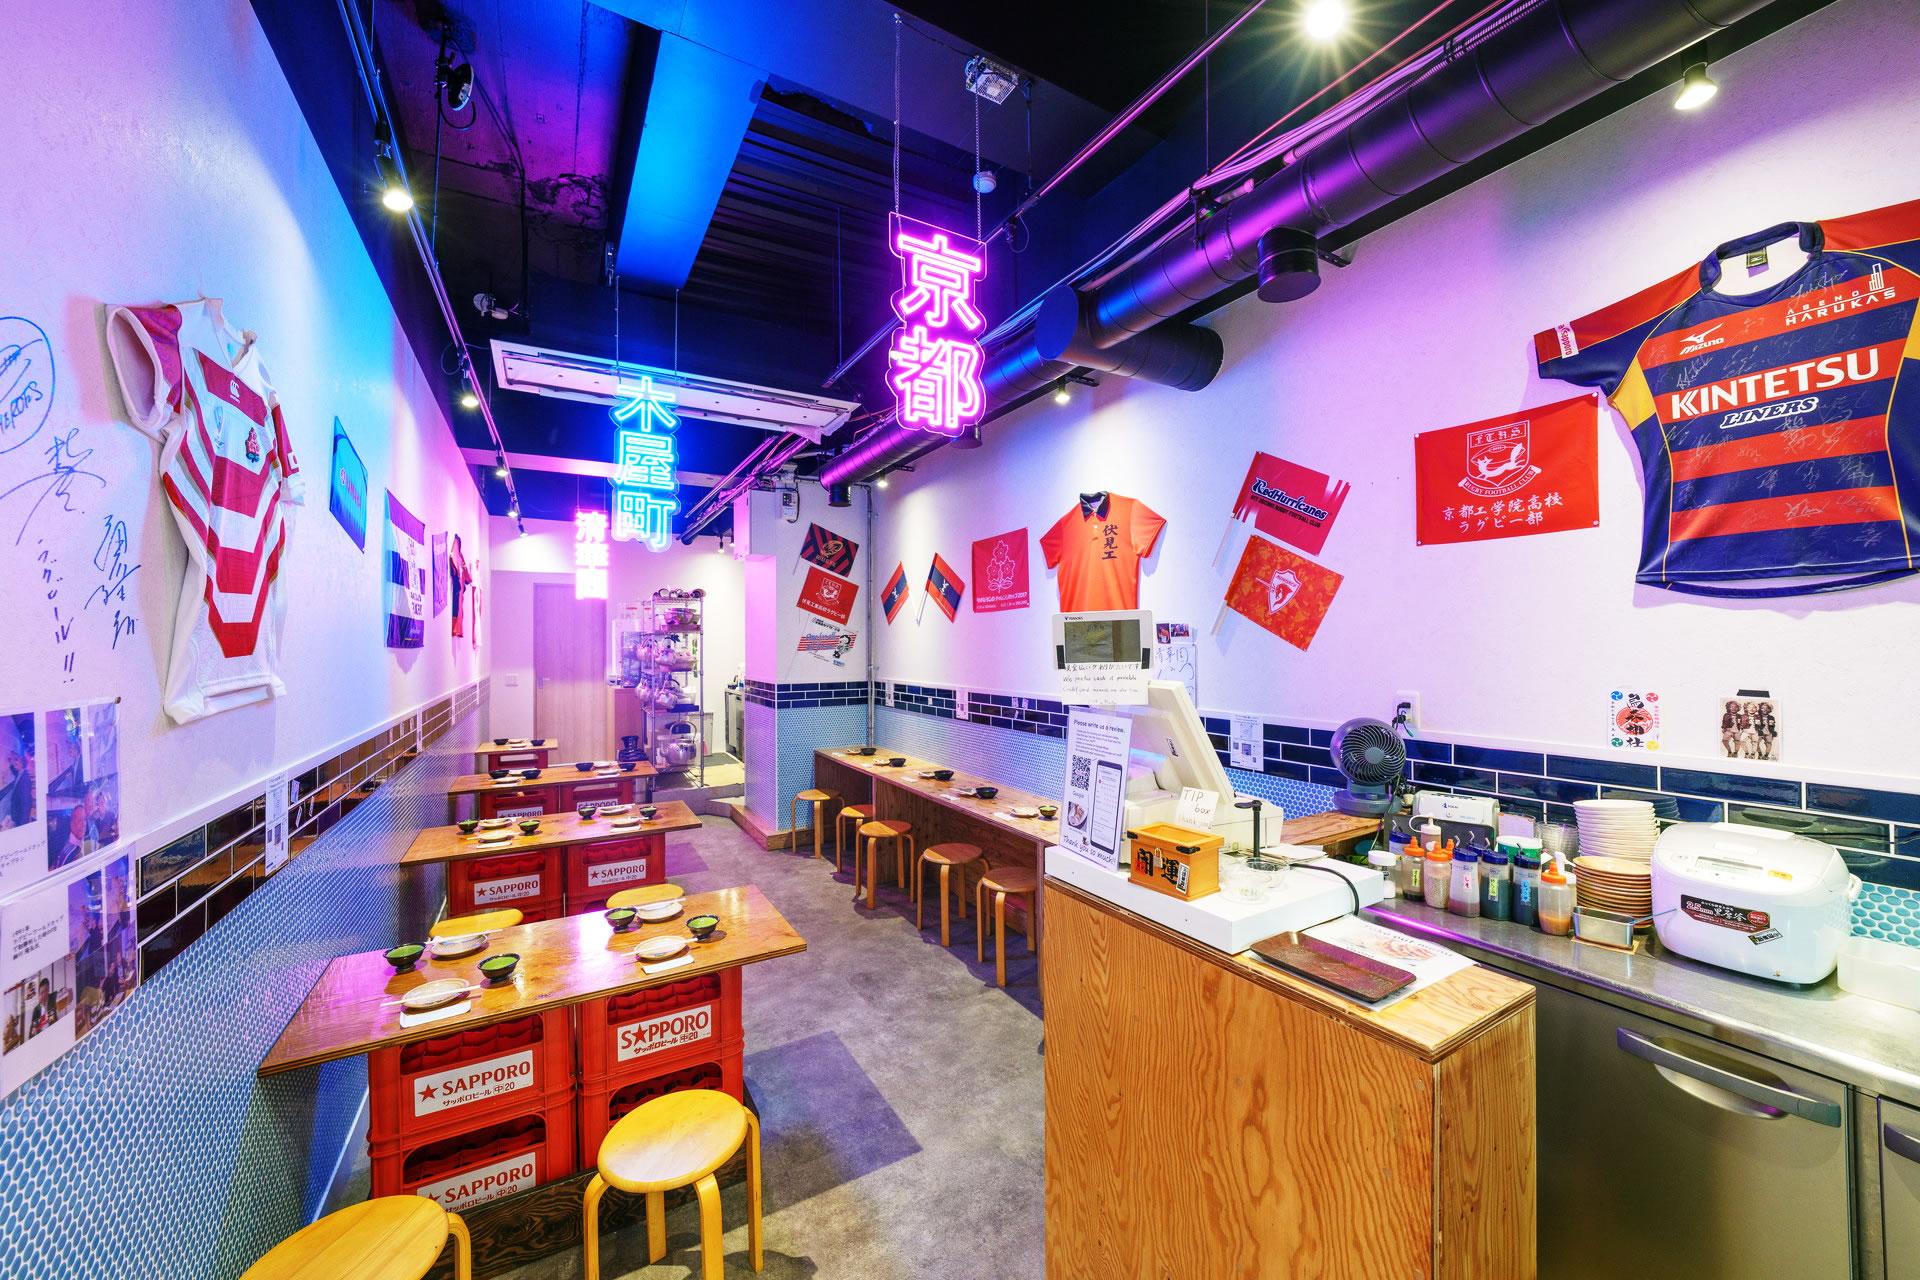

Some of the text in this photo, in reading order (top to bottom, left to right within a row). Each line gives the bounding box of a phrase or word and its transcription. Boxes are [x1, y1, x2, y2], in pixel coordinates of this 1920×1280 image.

[1785, 289, 1896, 326] HARUKAS
[1787, 290, 1859, 315] ABENO
[893, 233, 982, 428] 京都
[1671, 348, 1879, 419] KINTETSU
[1720, 397, 1819, 428] LINERS
[613, 375, 678, 548] 木屋町
[1251, 476, 1328, 520] RedHurricanes
[1442, 492, 1564, 521] 京都工学院高校
[1460, 511, 1543, 533] ラグビー部
[1102, 524, 1118, 560] 伏見工
[1184, 789, 1204, 802] TIP
[1194, 803, 1211, 815] box
[601, 864, 645, 879] SAPPORO
[489, 880, 538, 895] SAPPORO
[633, 1038, 678, 1055] サッポロビール
[442, 1061, 531, 1096] SAPPORO
[443, 1089, 491, 1107] サッポロビール
[444, 1163, 533, 1204] SAPPORO
